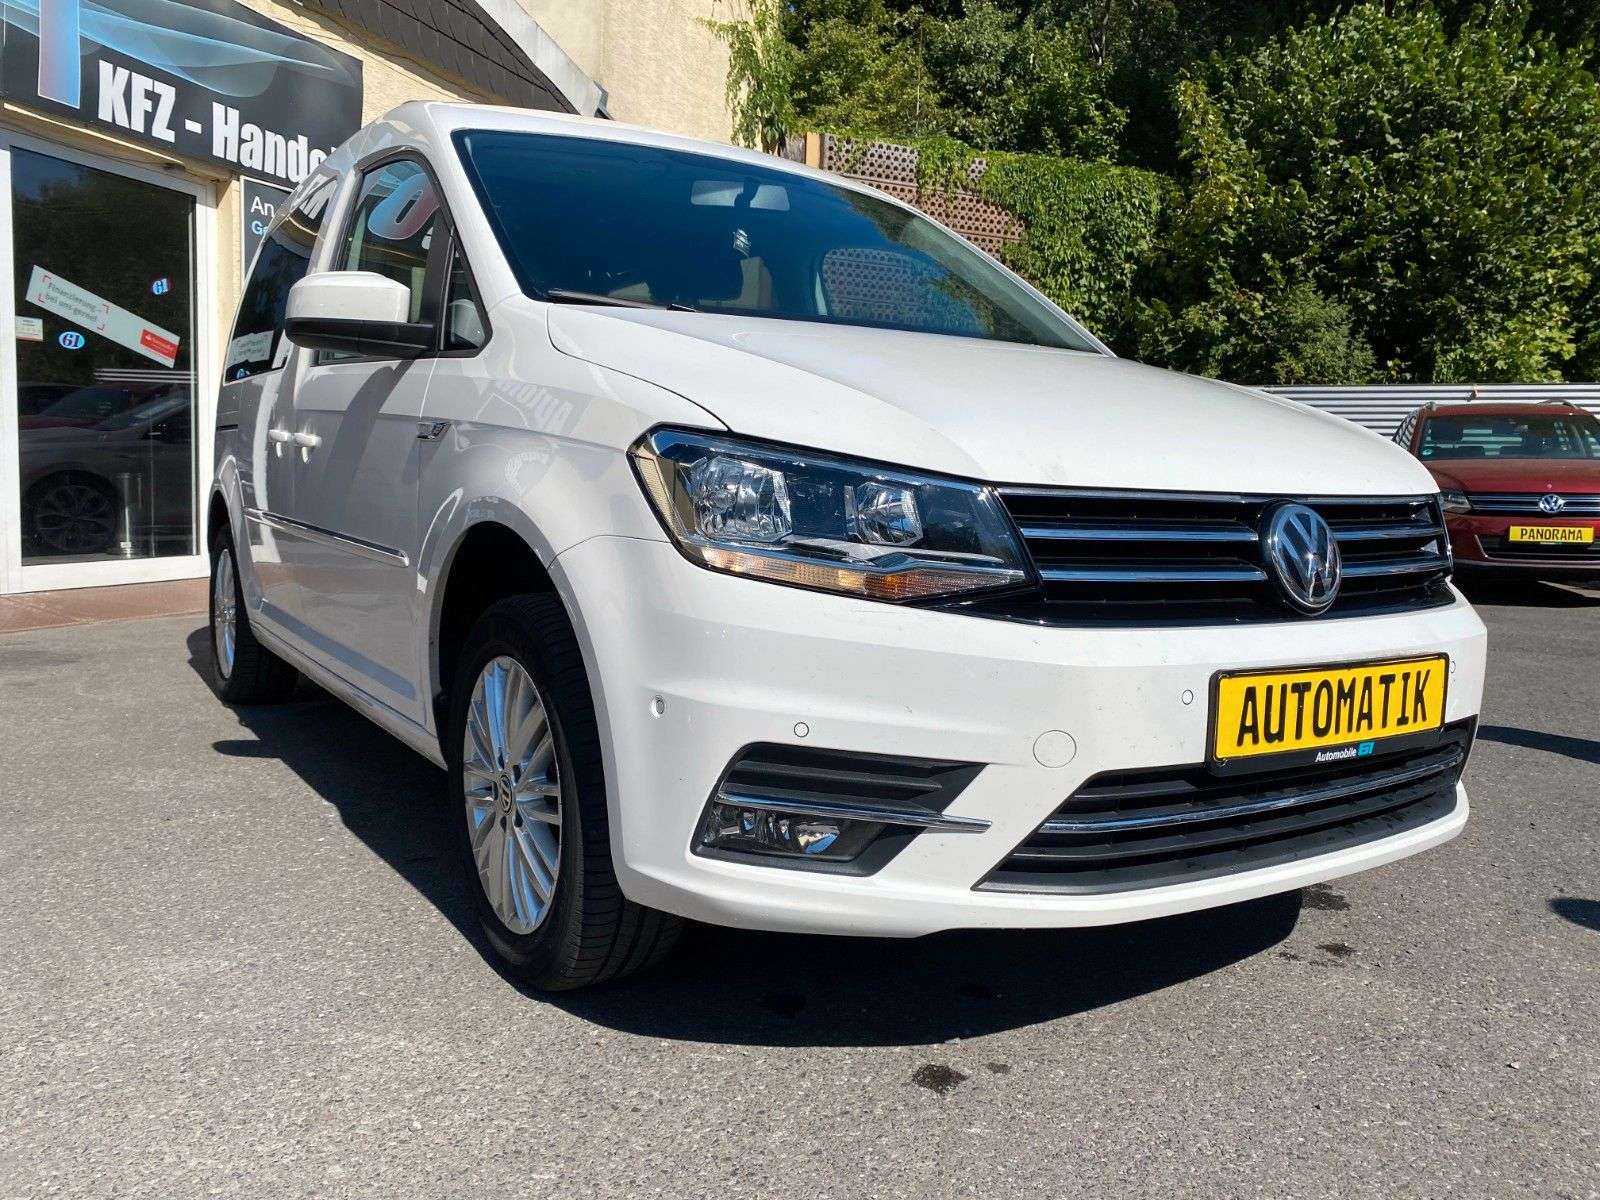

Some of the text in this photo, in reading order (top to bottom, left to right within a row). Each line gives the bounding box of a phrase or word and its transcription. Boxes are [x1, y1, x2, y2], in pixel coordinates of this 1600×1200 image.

[98, 60, 176, 143] KFZ
[1520, 528, 1583, 541] PANORAMA
[1236, 669, 1432, 748] AUTOMATIK
[1314, 745, 1357, 762] Automobile
